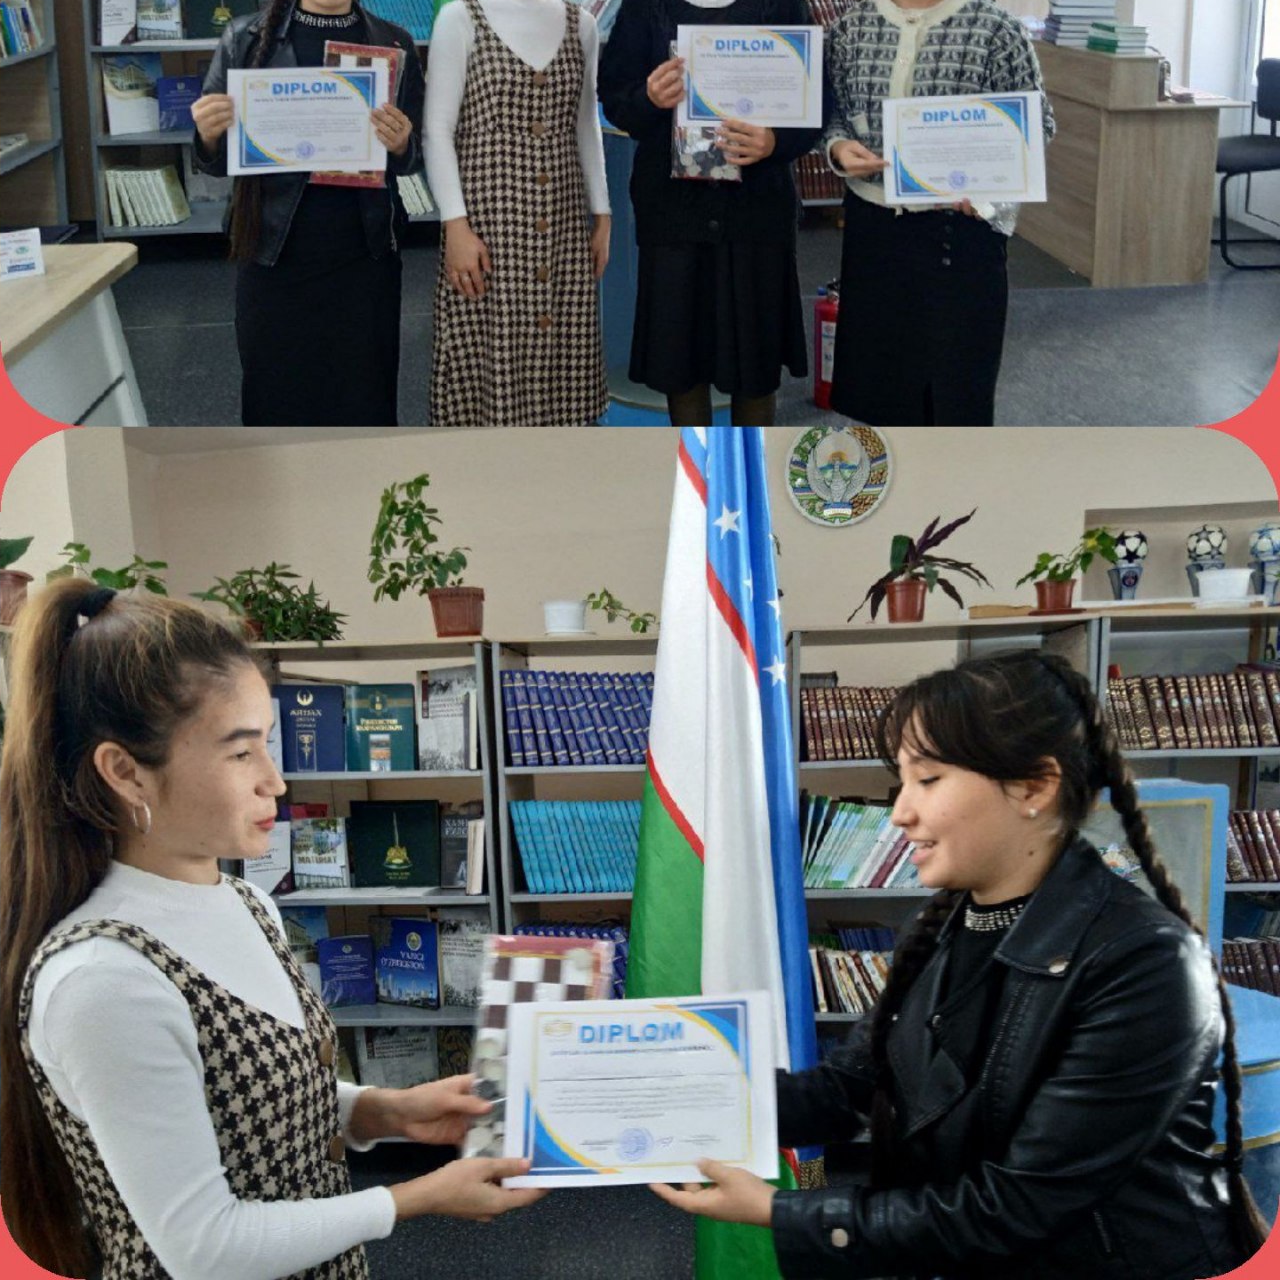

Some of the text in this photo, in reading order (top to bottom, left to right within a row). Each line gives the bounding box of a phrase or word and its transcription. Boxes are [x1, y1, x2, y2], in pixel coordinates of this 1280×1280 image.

[715, 39, 775, 52] DIPLOM
[272, 81, 337, 95] DIPLOM
[922, 108, 987, 123] DIPLOM
[579, 1021, 685, 1044] DIPLOM
